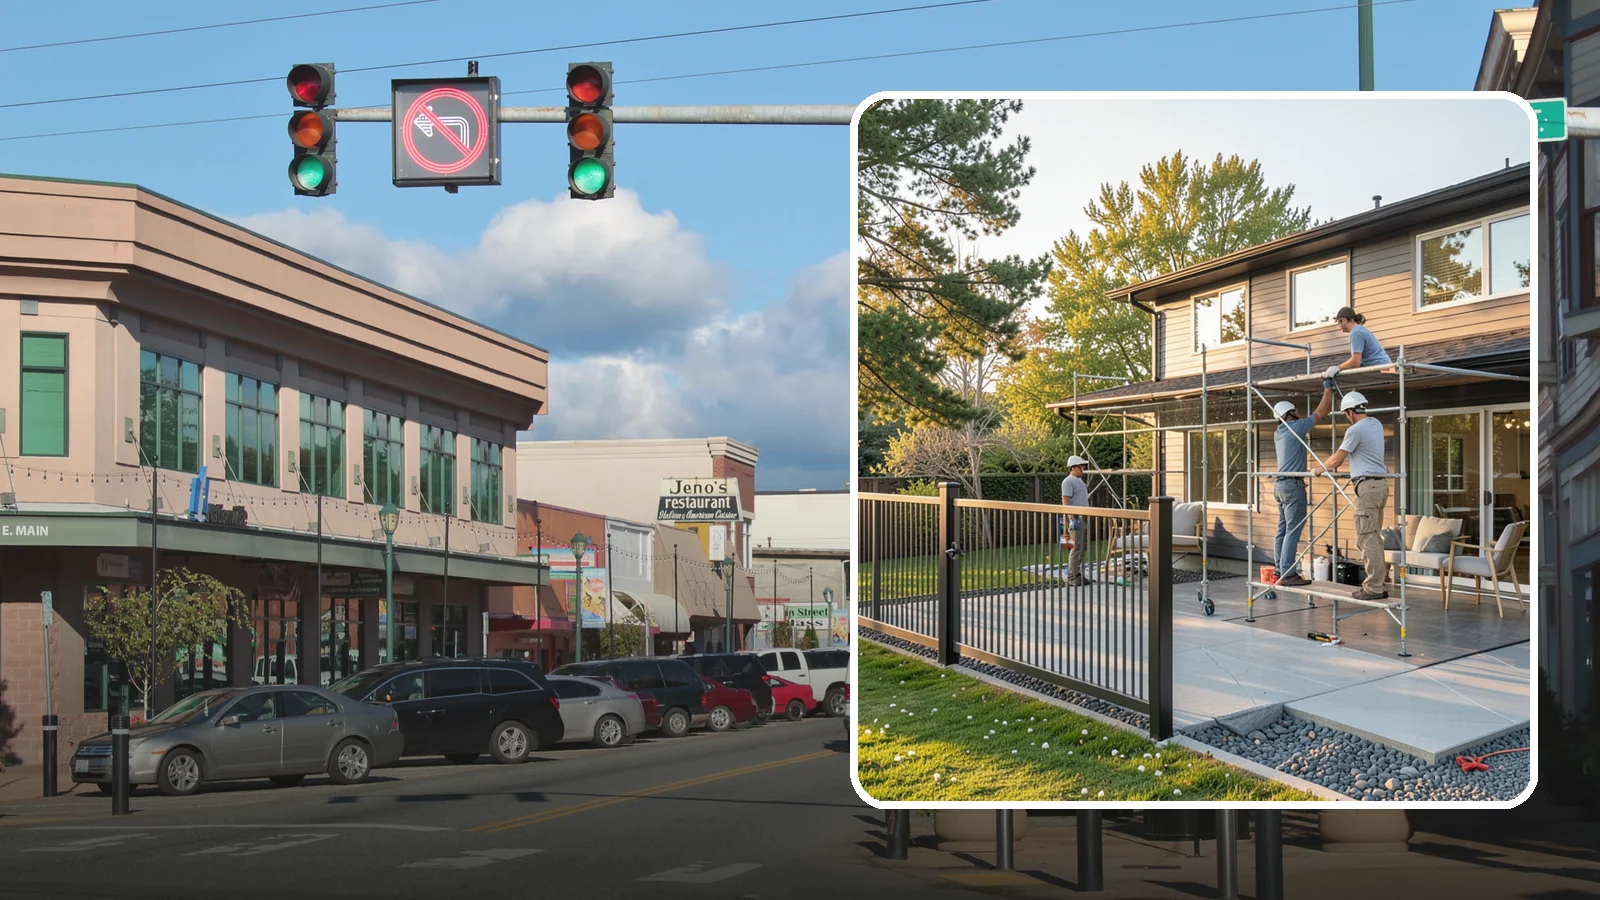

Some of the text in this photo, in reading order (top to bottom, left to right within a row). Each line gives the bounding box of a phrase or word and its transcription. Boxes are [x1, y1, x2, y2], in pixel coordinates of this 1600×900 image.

[670, 480, 727, 495] Jeno's
[665, 497, 731, 509] restaurant
[659, 510, 681, 520] Italian
[686, 510, 715, 519] American
[715, 510, 738, 519] Cuisine
[2, 525, 49, 536] E. MAIN
[797, 607, 828, 616] Street
